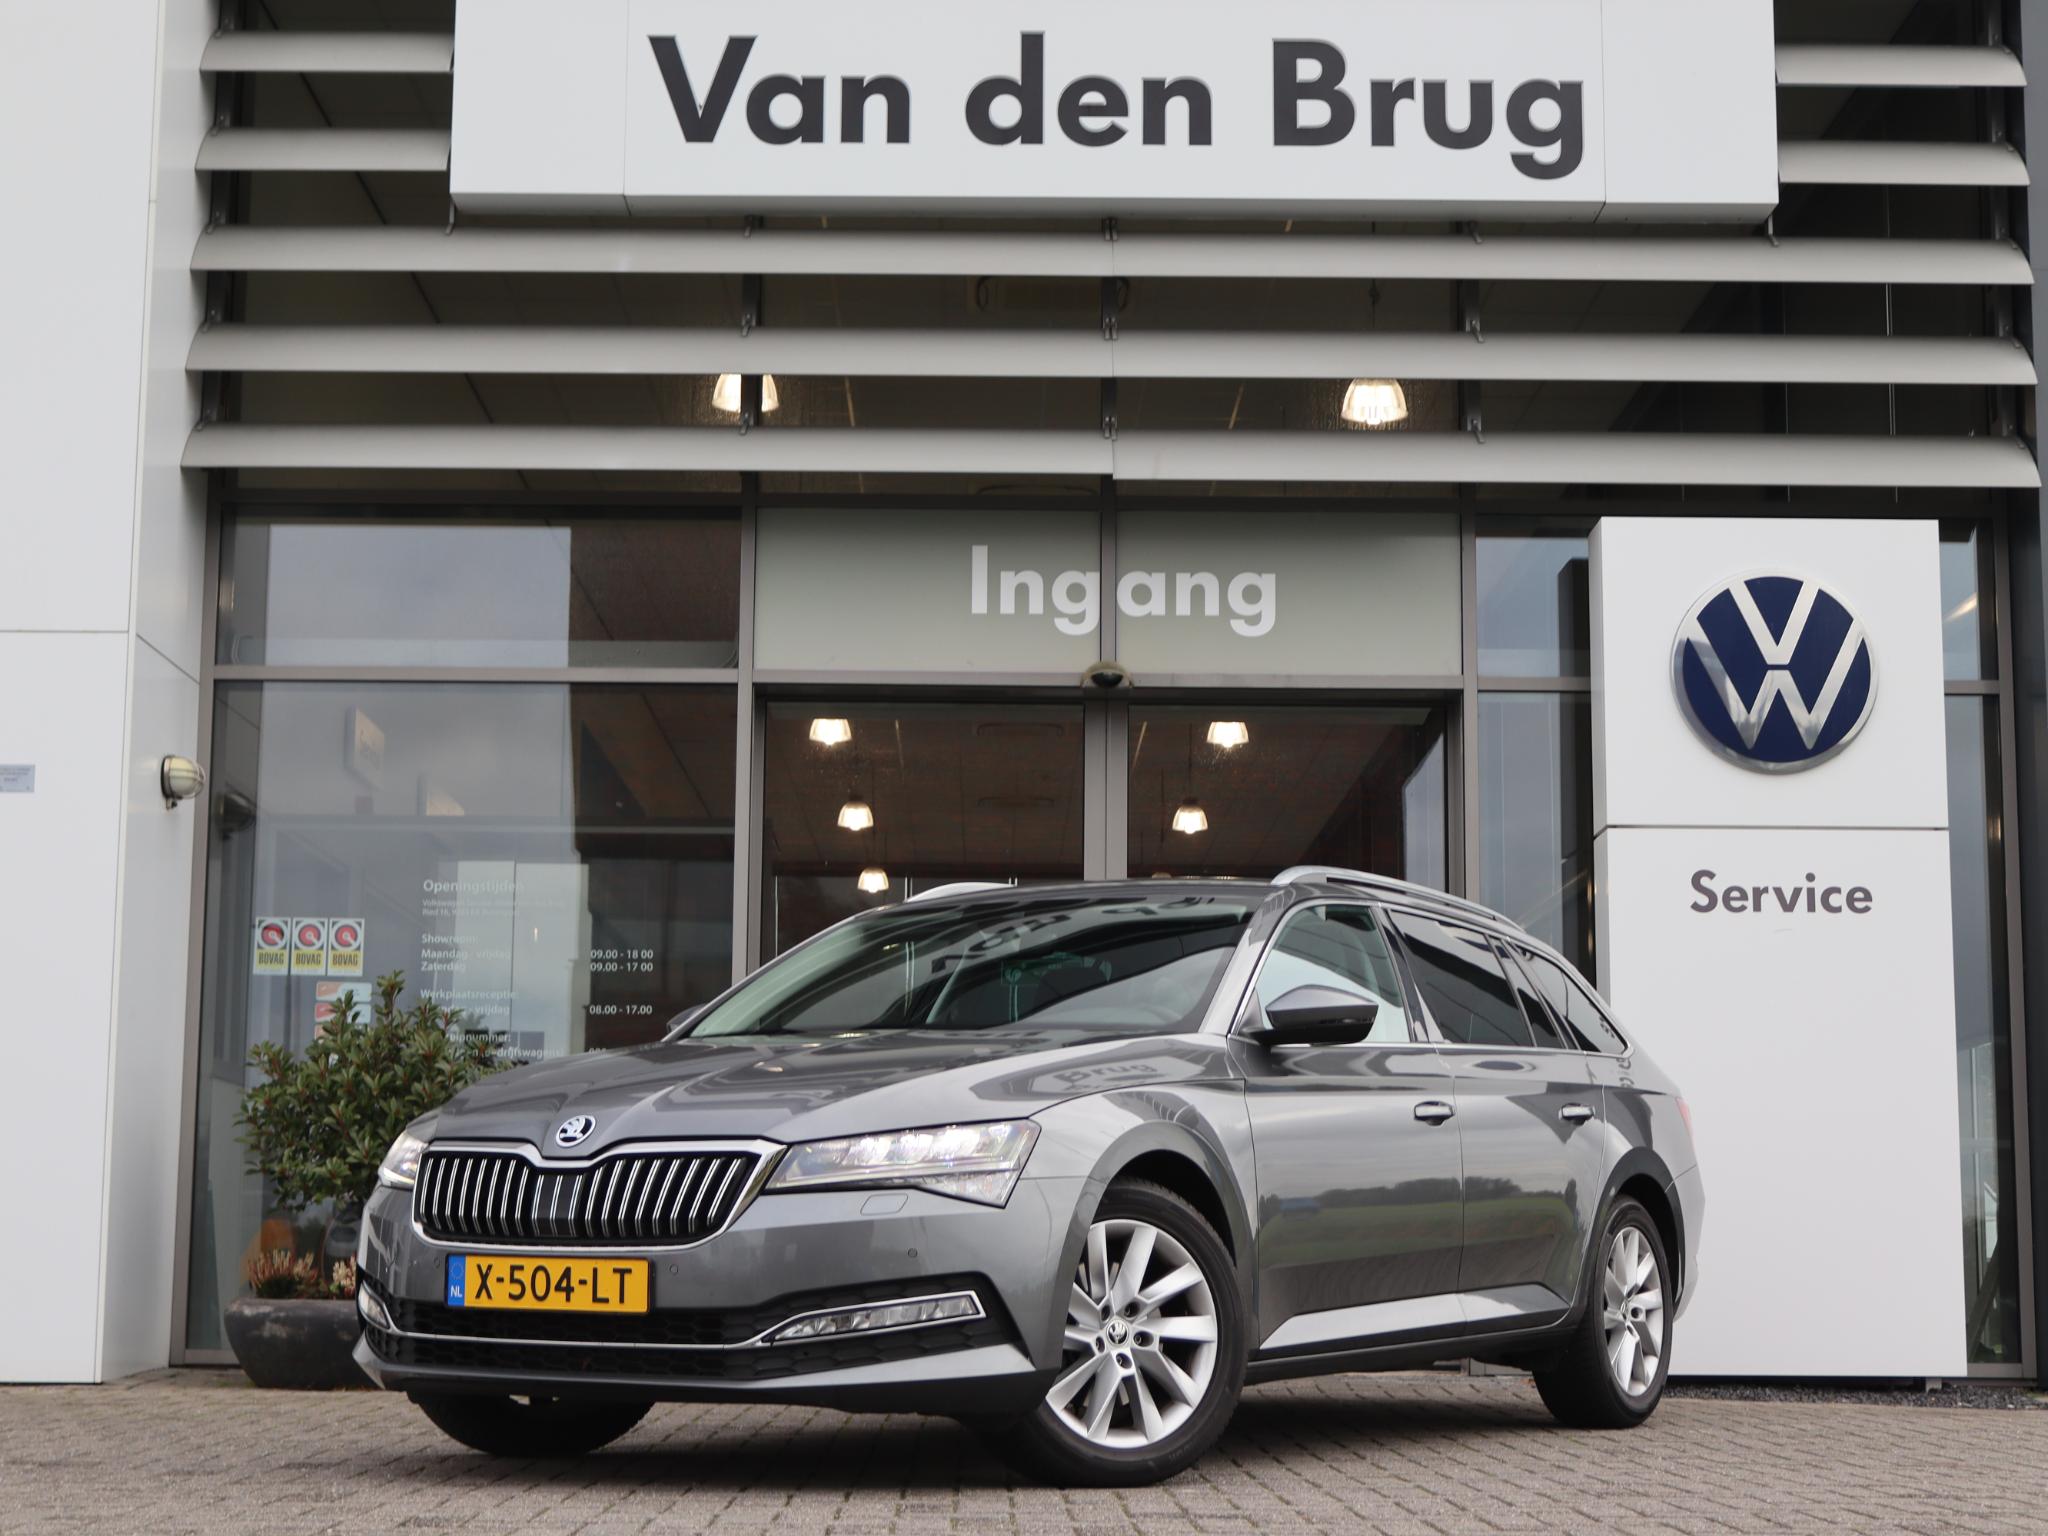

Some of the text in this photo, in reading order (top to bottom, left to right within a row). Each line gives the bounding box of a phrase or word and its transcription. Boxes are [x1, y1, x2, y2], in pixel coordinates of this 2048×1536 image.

[647, 30, 1585, 181] Van den Brug
[971, 544, 1277, 638] Ingang
[423, 880, 526, 895] Openingstijden
[1690, 868, 1874, 914] Service
[258, 952, 284, 965] BOVAG
[296, 953, 321, 966] BOVAG
[332, 953, 358, 966] BOVAG
[421, 949, 468, 961] Maandag
[590, 949, 618, 959] 09.00
[420, 961, 467, 974] Zaterdag
[589, 962, 618, 972] 09.00
[589, 1004, 617, 1015] 08.00
[626, 1004, 653, 1015] 17.00
[475, 1263, 633, 1305] X-504-LT
[450, 1285, 463, 1299] NL
